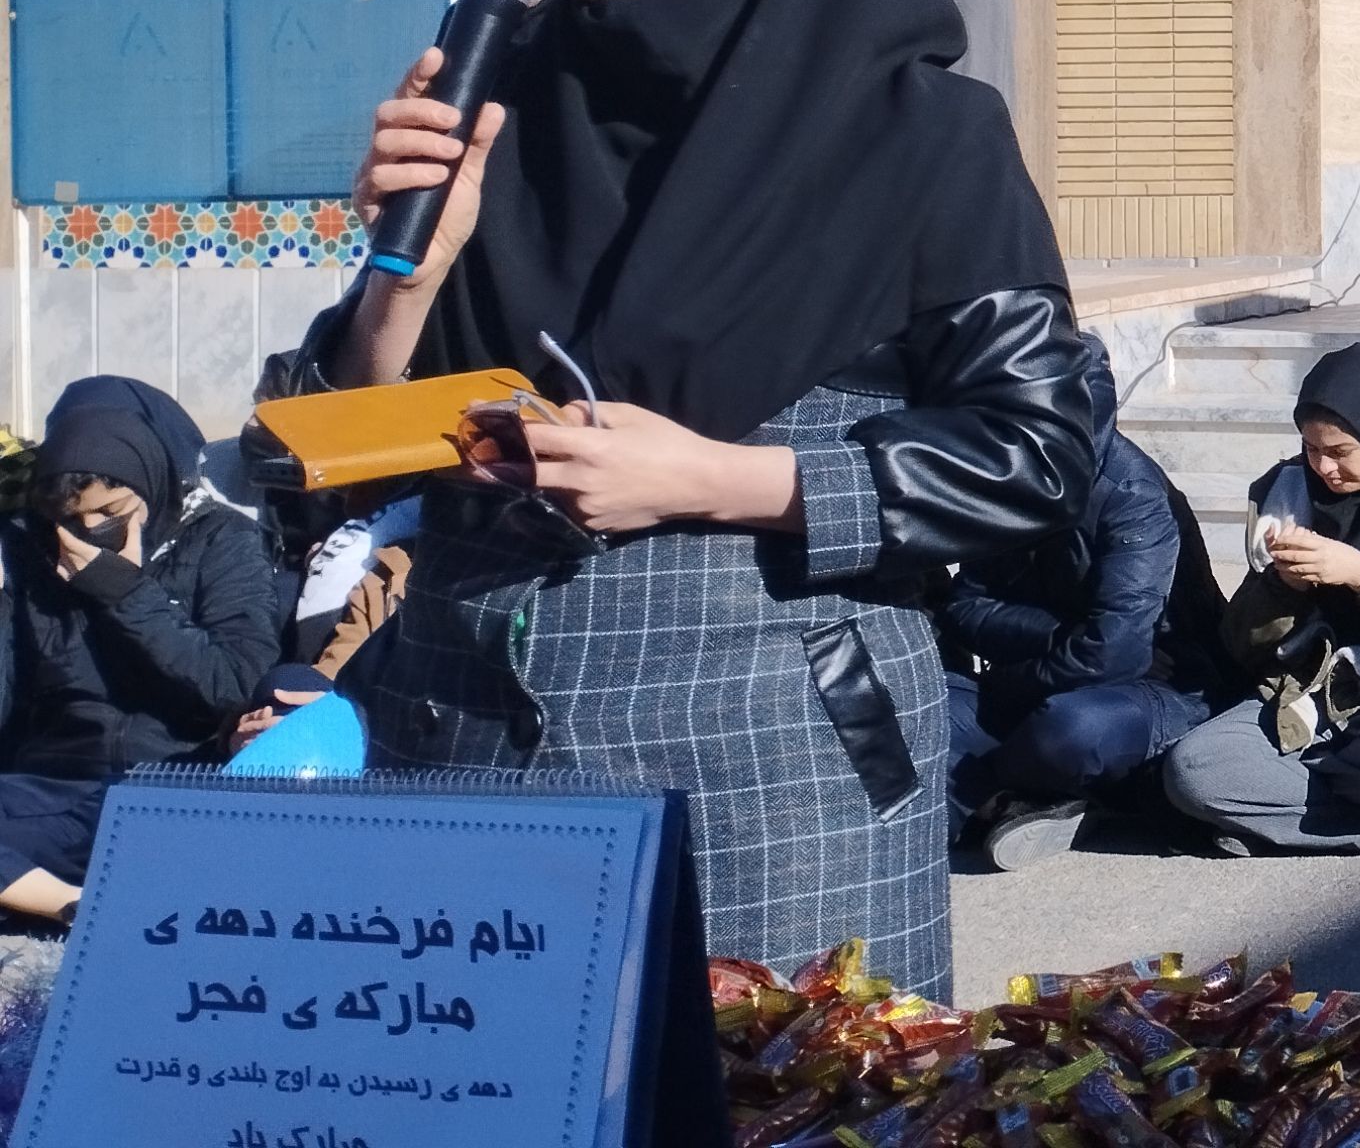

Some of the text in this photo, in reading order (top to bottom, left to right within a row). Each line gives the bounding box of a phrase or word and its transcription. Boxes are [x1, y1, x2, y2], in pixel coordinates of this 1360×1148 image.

[143, 906, 546, 962] ایام فرخنده دهه ی
[176, 975, 476, 1035] مبارکه ی فجر
[115, 1054, 182, 1083] قدرت
[186, 1066, 200, 1086] و
[207, 1060, 268, 1089] بلندی
[275, 1064, 311, 1093] اوج
[318, 1071, 341, 1094] به
[348, 1072, 433, 1101] رسیدن
[467, 1077, 513, 1099] دهه
